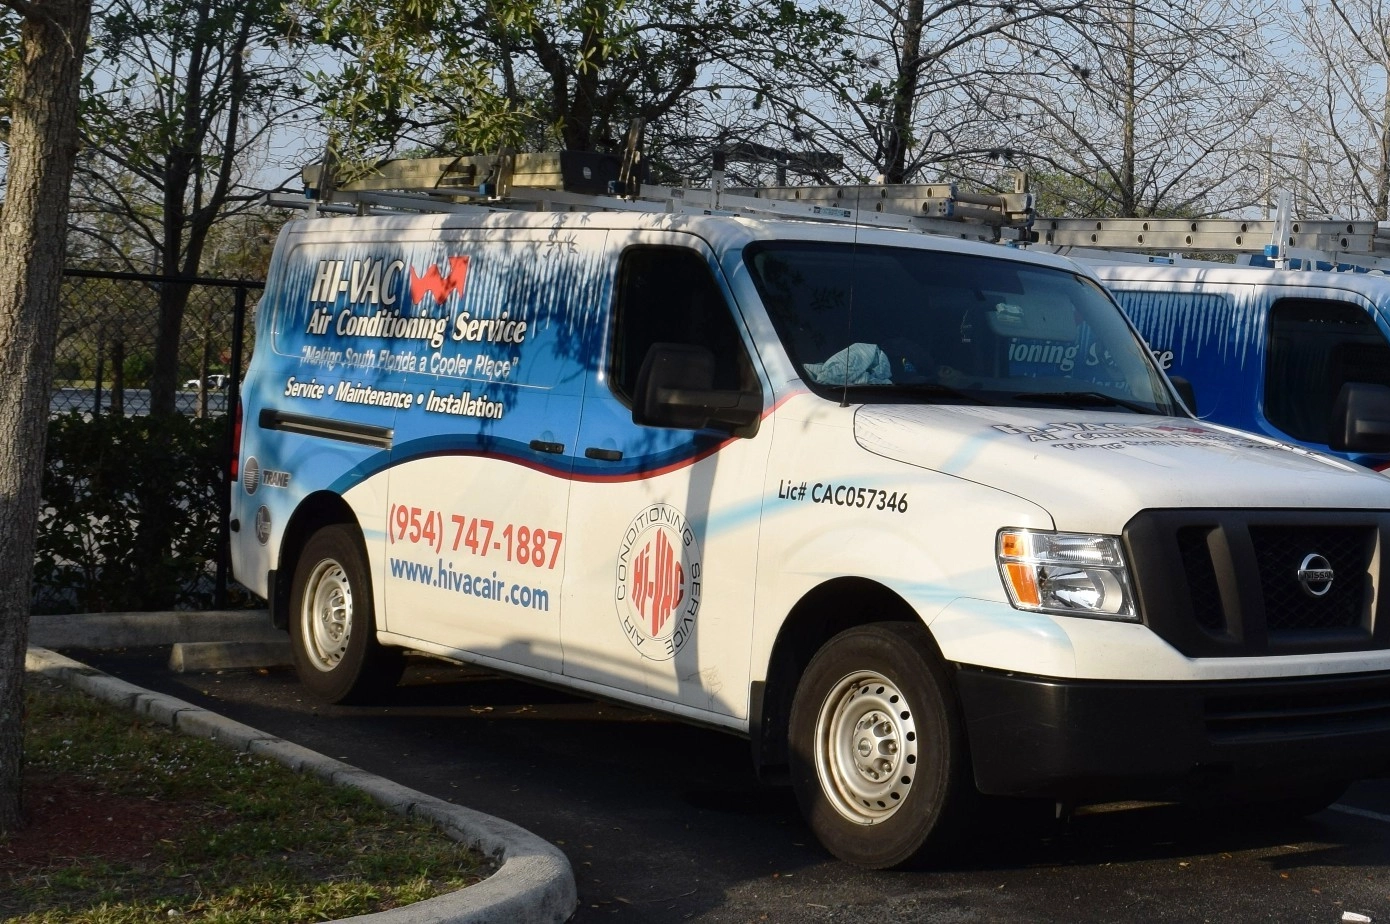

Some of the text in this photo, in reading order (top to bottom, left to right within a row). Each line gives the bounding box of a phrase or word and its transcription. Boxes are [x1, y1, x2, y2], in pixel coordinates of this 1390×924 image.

[311, 258, 404, 305] HI-VAC
[306, 308, 527, 348] Air Conditioning Service
[345, 348, 375, 368] South
[377, 349, 416, 372] Florida
[419, 358, 427, 372] a
[430, 352, 472, 376] Cooler
[284, 376, 504, 419] Service Maintenance Installation
[262, 469, 290, 488] TRANE
[778, 479, 908, 513] Lic# CAC057346
[389, 503, 563, 570] (954) 747-1887
[390, 557, 549, 612] www.hivacair.com
[617, 507, 701, 655] AIR CONDITIONING SERVICE
